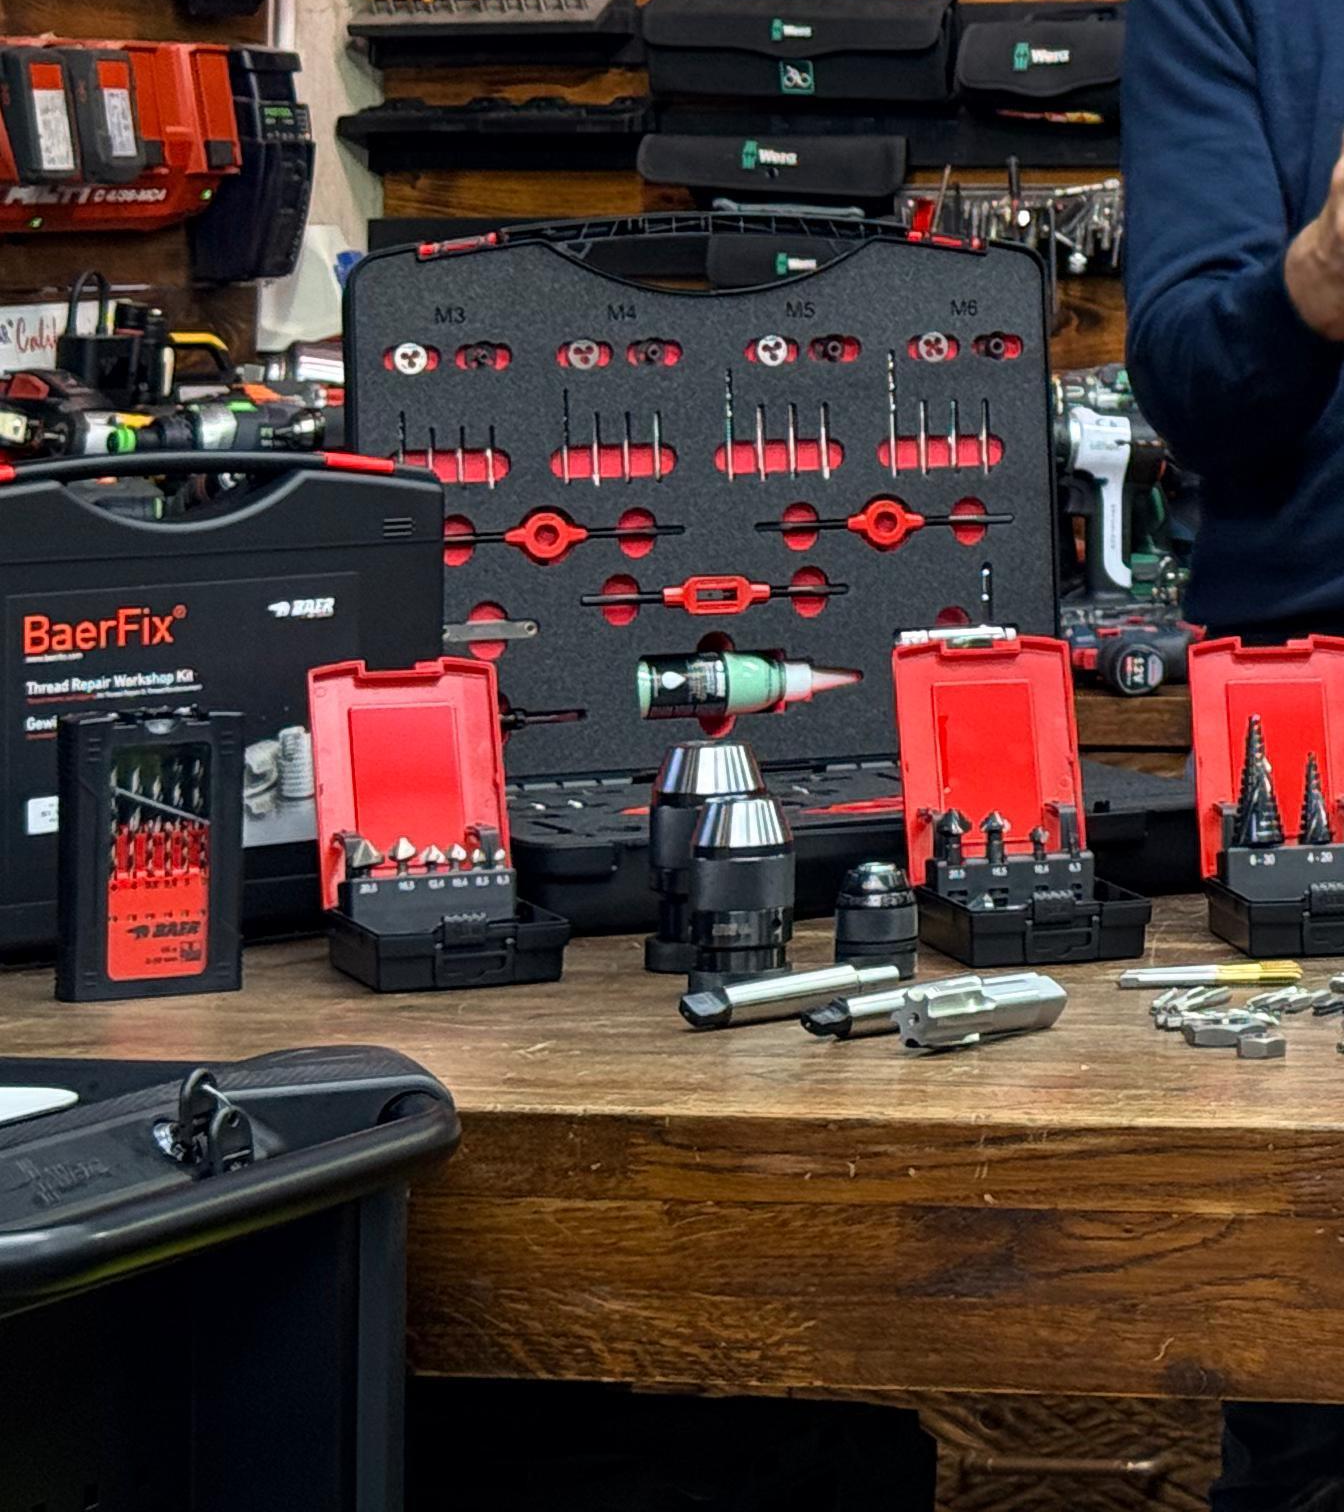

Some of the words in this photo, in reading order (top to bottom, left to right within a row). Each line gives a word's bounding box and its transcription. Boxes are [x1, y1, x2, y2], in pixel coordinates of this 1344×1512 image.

[1030, 48, 1070, 64] Wera
[758, 149, 798, 166] Wera
[434, 307, 466, 325] M3
[607, 303, 637, 321] M4
[786, 300, 816, 318] M5
[950, 299, 978, 317] M6
[291, 597, 335, 616] BAER
[26, 680, 70, 695] Thread
[71, 677, 111, 693] Repair
[114, 670, 175, 690] Workshop
[176, 668, 195, 683] Kit
[26, 716, 58, 732] Gewi
[152, 921, 201, 938] BAER
